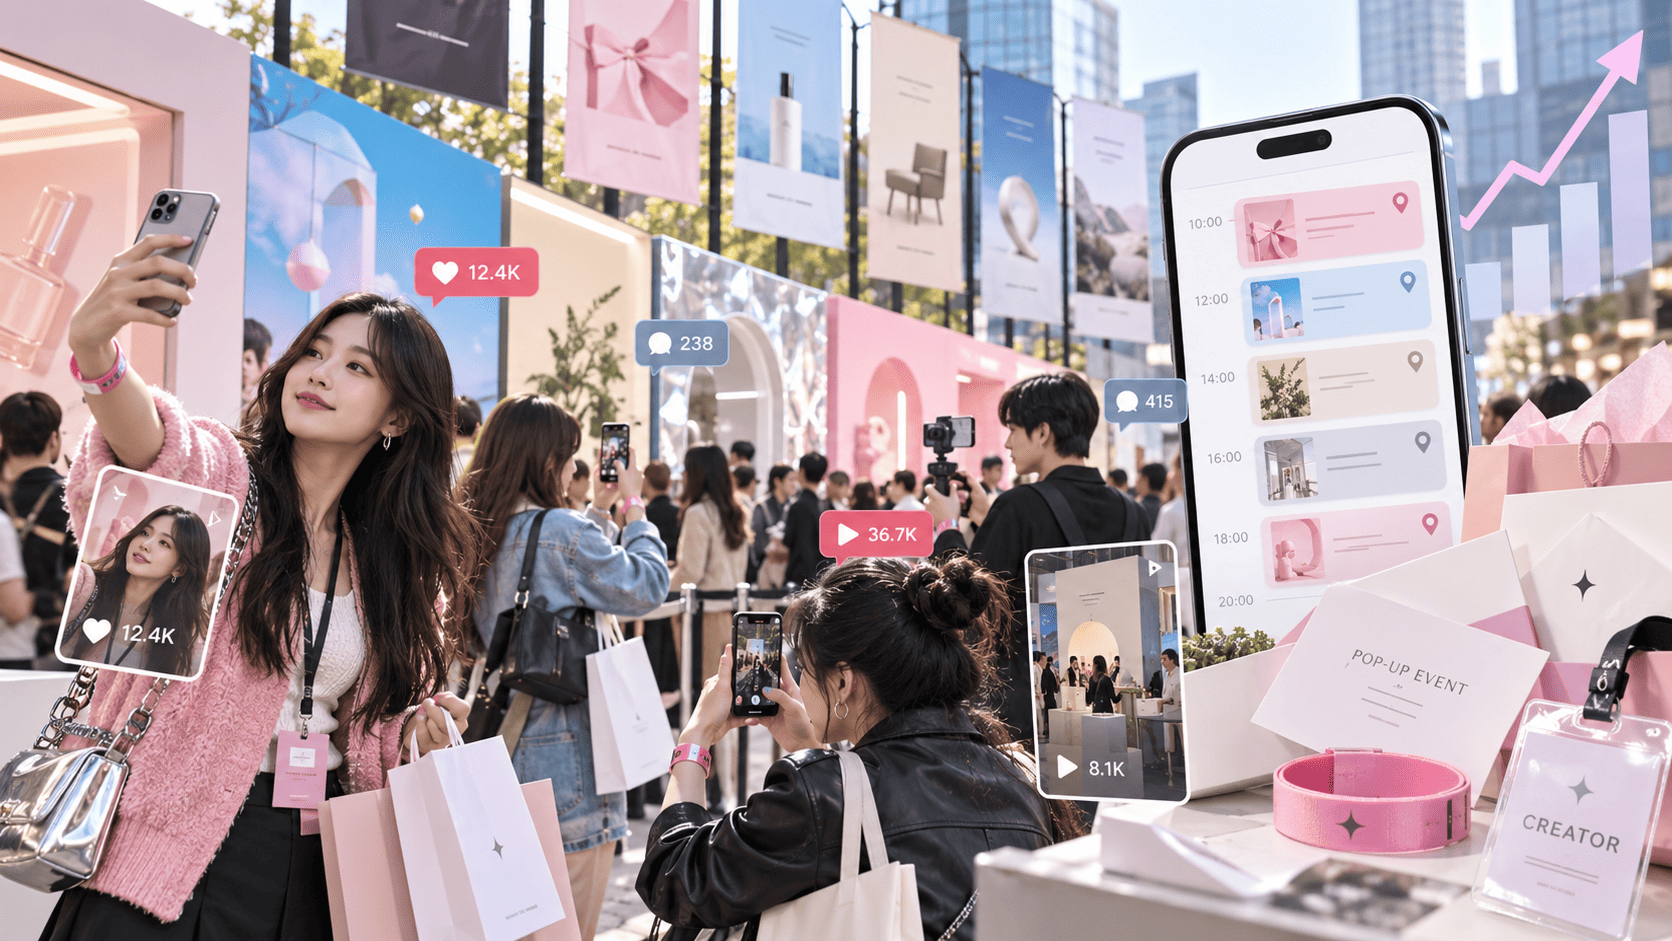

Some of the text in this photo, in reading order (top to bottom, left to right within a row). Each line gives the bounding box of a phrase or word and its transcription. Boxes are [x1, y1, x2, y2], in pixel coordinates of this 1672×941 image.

[1188, 216, 1223, 229] 10:00
[1194, 292, 1229, 306] 12:00
[1201, 371, 1235, 385] 14:00
[1207, 450, 1242, 464] 16:00
[1213, 531, 1249, 545] 18:00
[1218, 594, 1254, 608] 20:00
[1351, 649, 1469, 695] POP-UP EVENT
[1522, 814, 1621, 854] CREATOR
